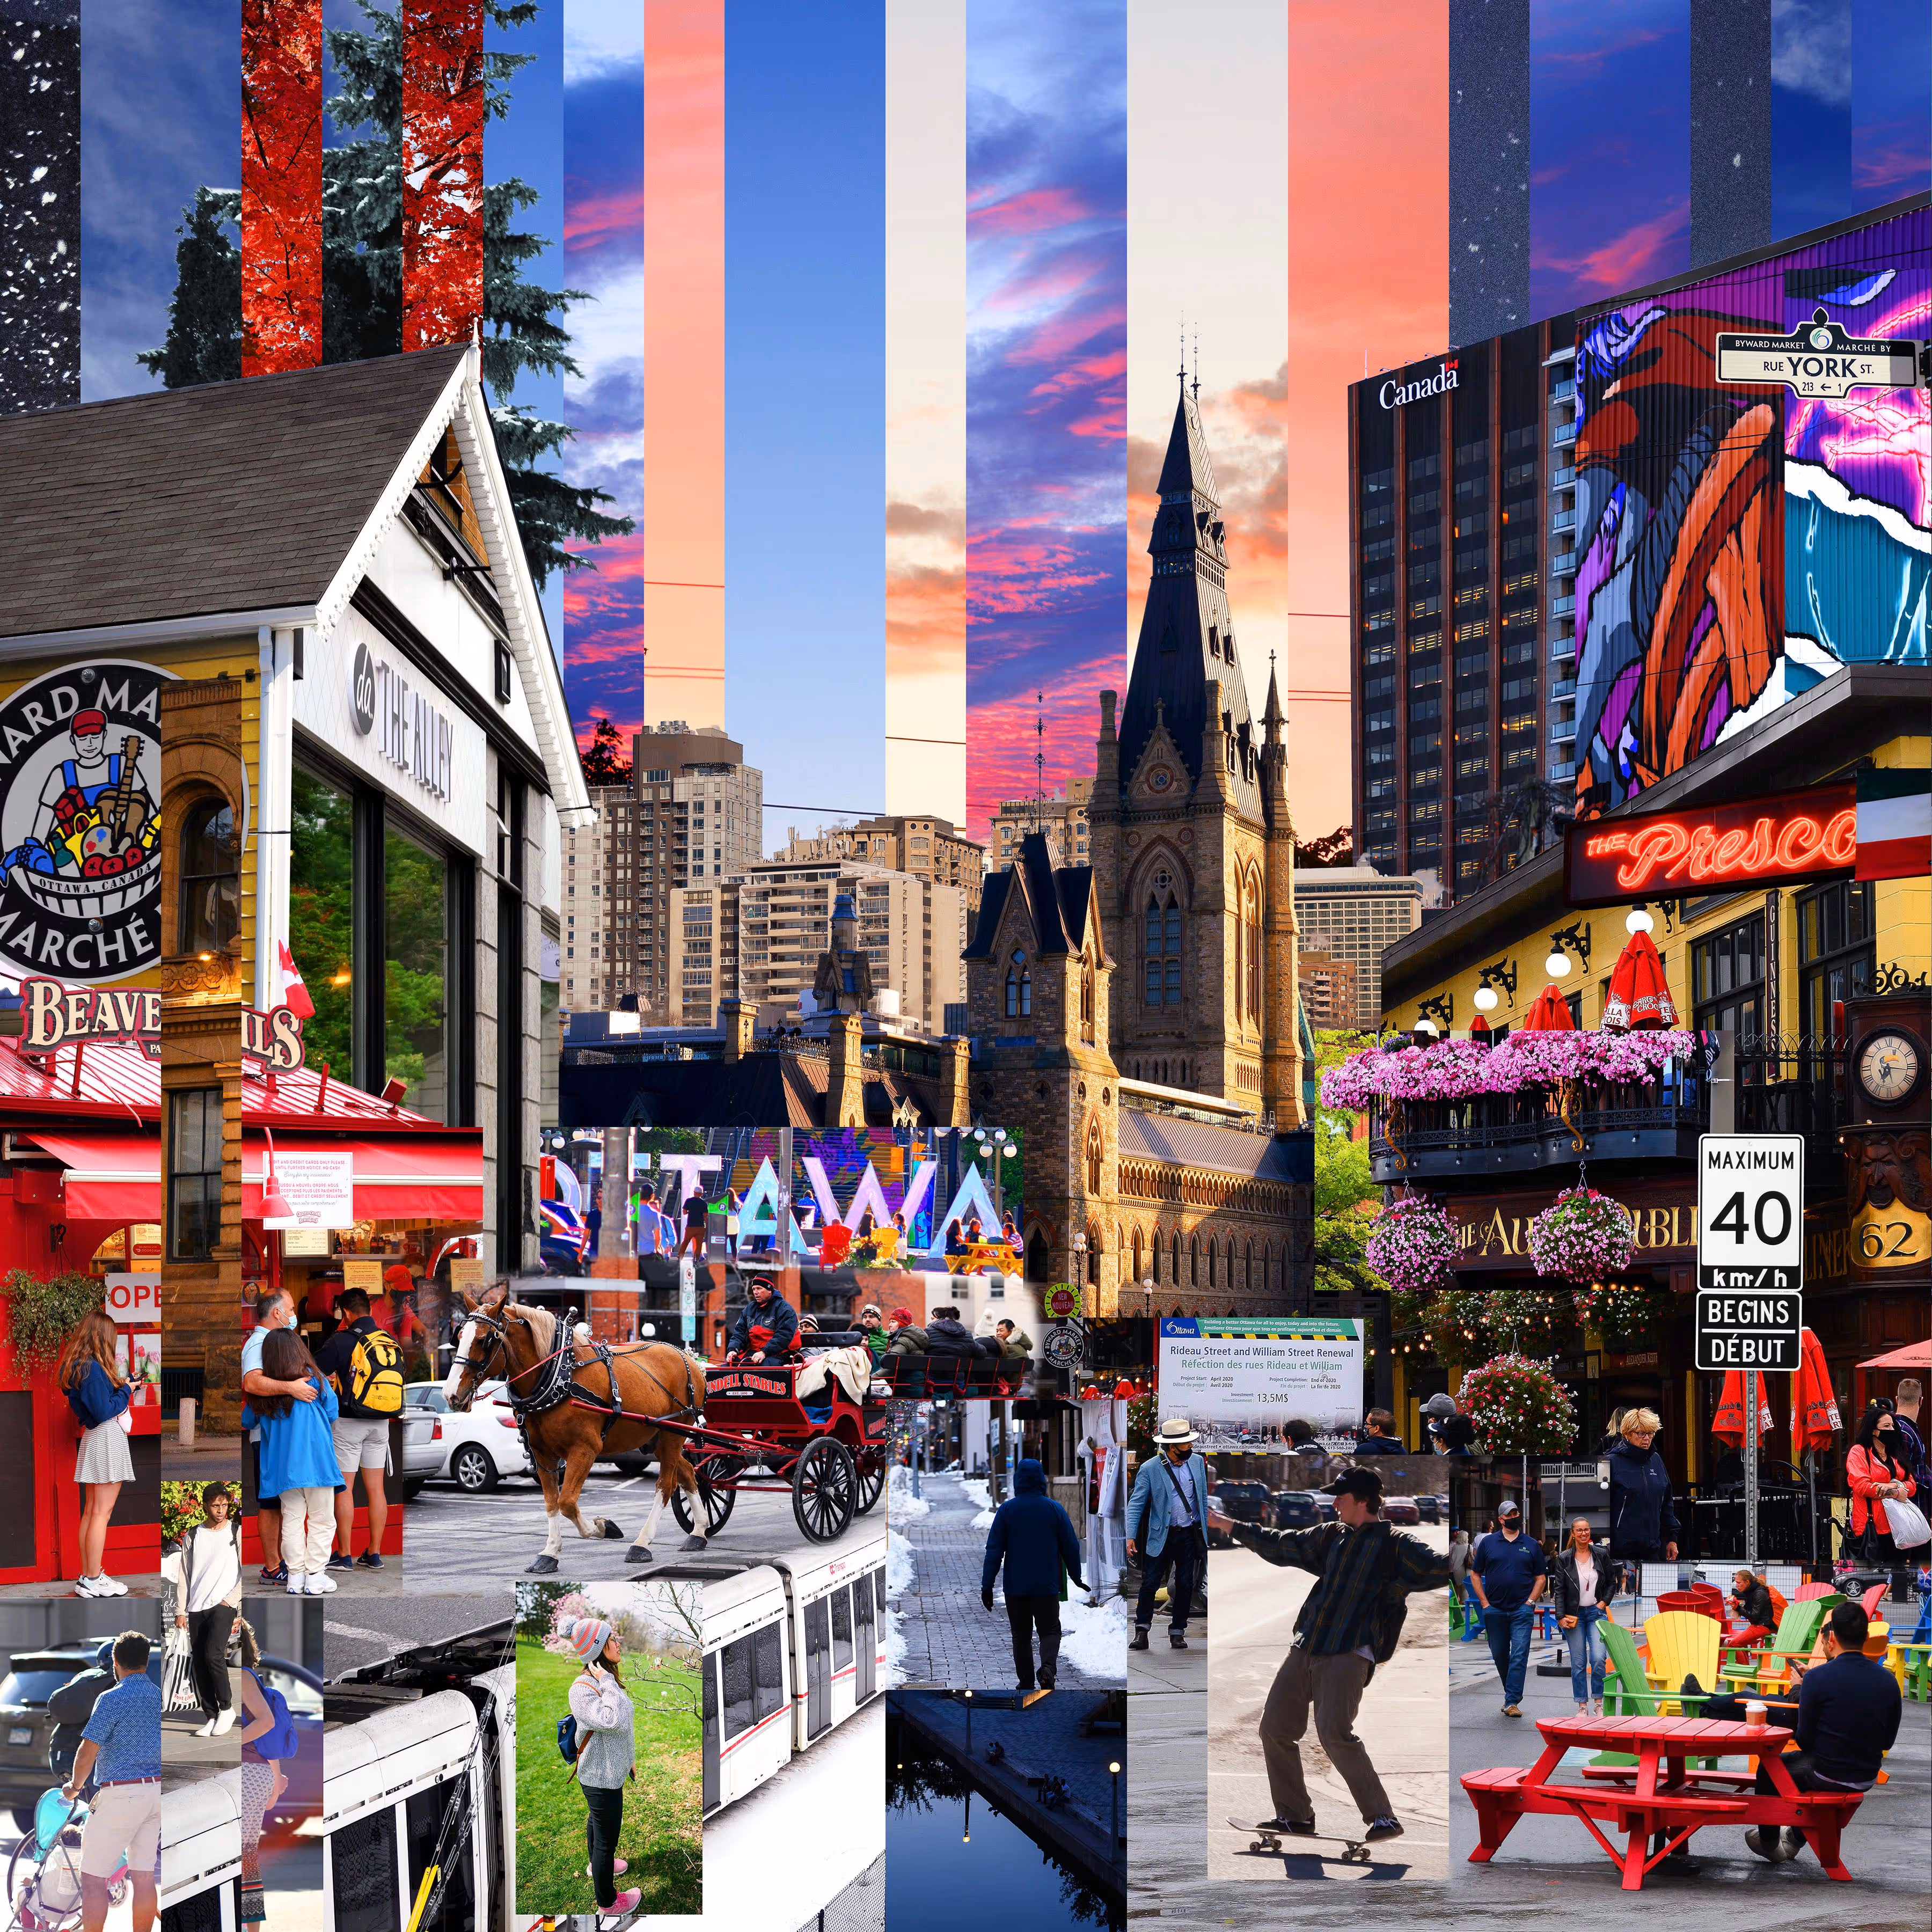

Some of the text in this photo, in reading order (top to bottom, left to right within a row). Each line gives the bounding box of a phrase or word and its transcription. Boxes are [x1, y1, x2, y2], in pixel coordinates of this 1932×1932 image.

[1735, 339, 1805, 350] BYWARD MARKET
[1836, 343, 1876, 352] MARCHÉ
[1763, 357, 1875, 378] RUE YORK ST.
[1379, 363, 1459, 409] Canada
[1802, 382, 1841, 392] 213 1
[94, 677, 161, 729] MA
[376, 658, 453, 803] THE ALLEY
[1586, 833, 1633, 858] THE
[39, 862, 152, 894] OTTAWA, CANADA
[1708, 1151, 1794, 1170] MAXIMUM
[1710, 1191, 1792, 1246] 40
[1858, 1221, 1920, 1258] 62
[1714, 1268, 1787, 1288] km/h
[1052, 1300, 1074, 1309] NOUVEAU
[1708, 1300, 1790, 1324] BEGINS
[1168, 1322, 1195, 1334] Ottawa
[1045, 1329, 1082, 1349] BYWARD MARKET
[1073, 1354, 1079, 1363] BY
[1170, 1346, 1353, 1357] Rideau Street and William Street Renewal
[1711, 1335, 1785, 1364] DÉBUT
[1182, 1359, 1224, 1368] Réfection
[1227, 1360, 1242, 1368] des
[1267, 1360, 1296, 1370] Rideau
[1310, 1362, 1342, 1371] William
[743, 1373, 786, 1395] STABLES
[1257, 1393, 1288, 1403] 13,5M$
